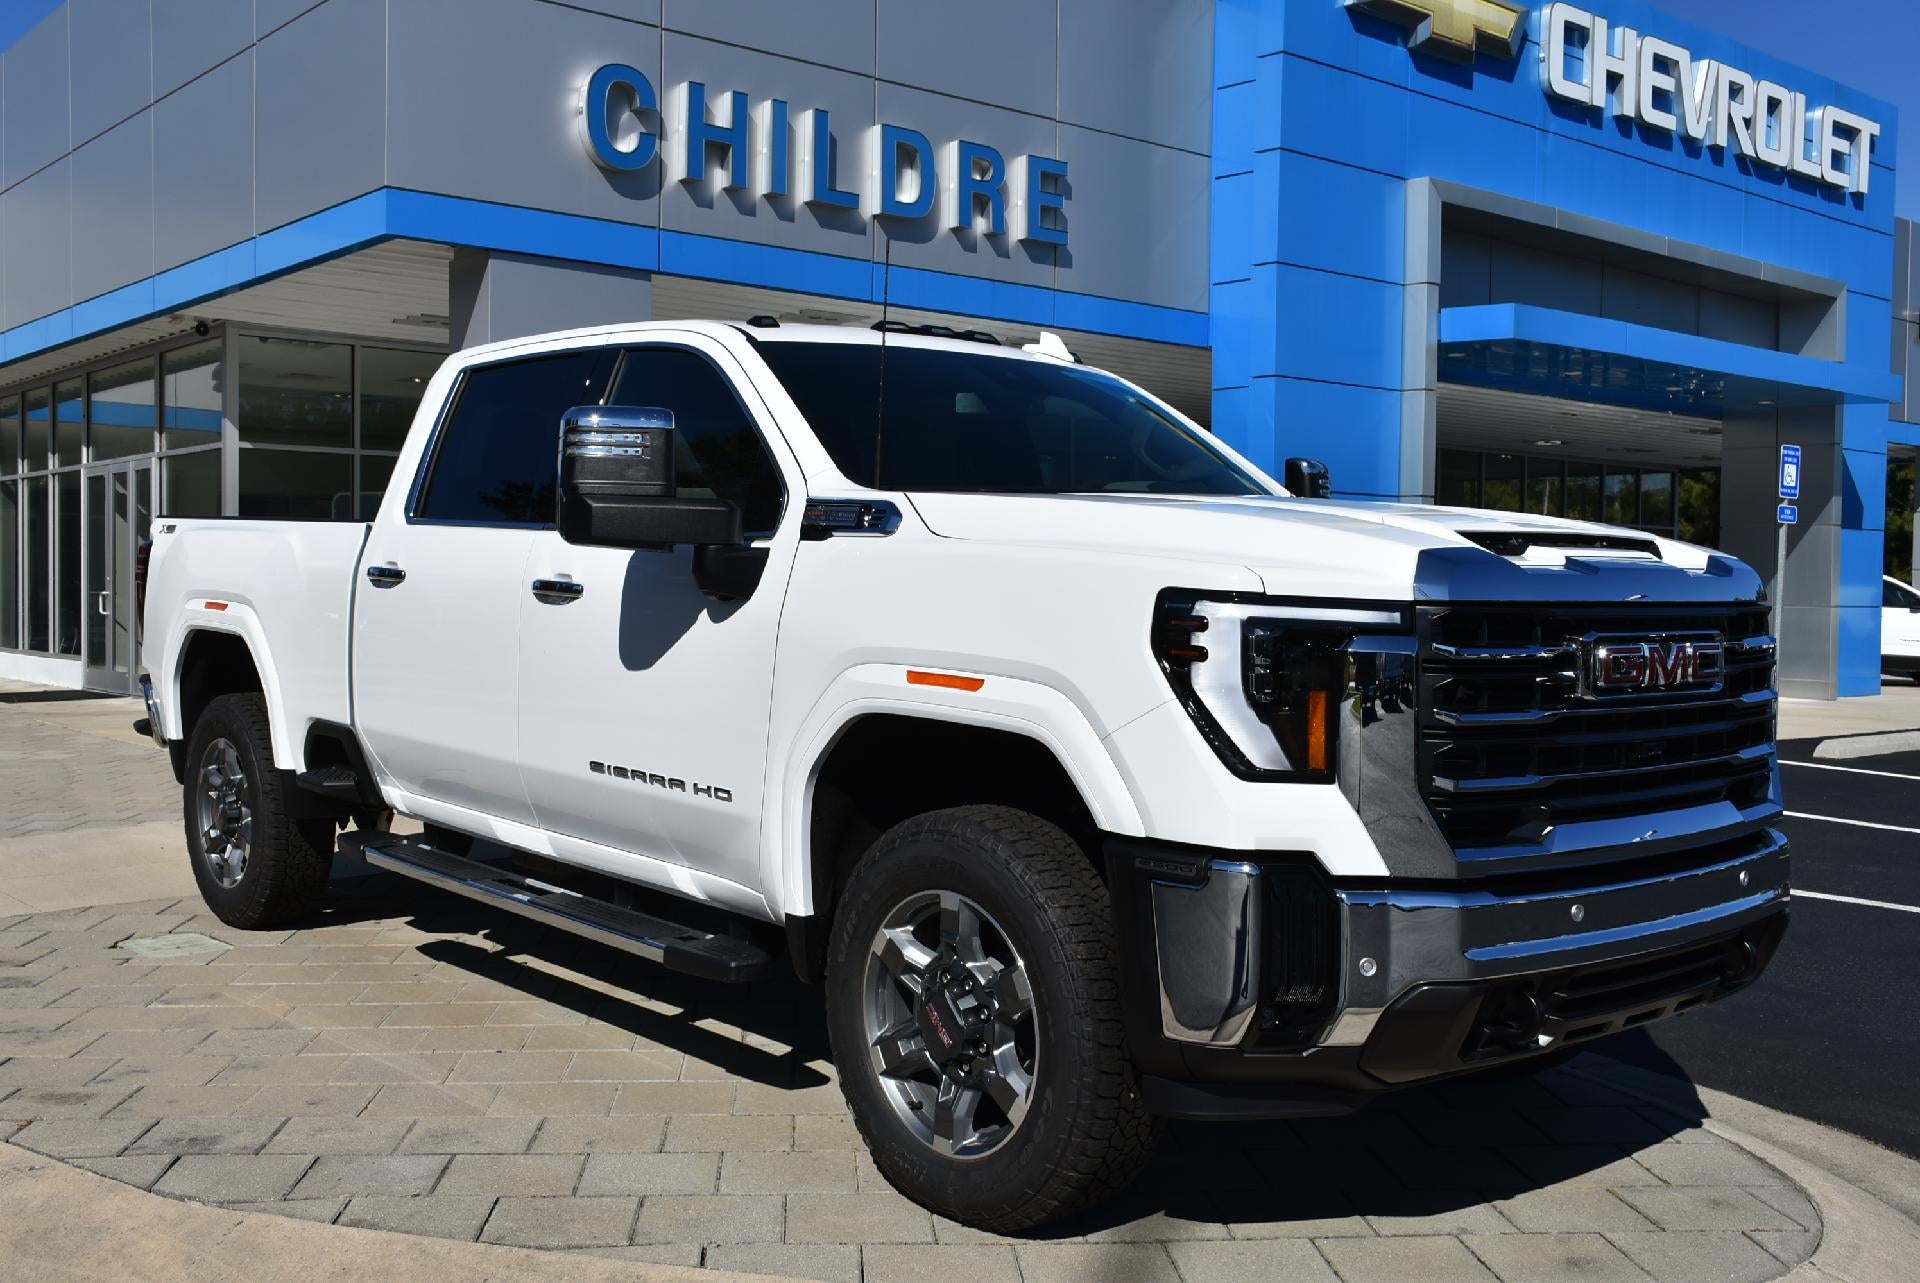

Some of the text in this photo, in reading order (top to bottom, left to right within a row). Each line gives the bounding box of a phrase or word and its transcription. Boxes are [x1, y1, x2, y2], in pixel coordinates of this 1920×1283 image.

[1544, 2, 1880, 194] CHEVROLET
[581, 63, 1069, 246] CHILDRE
[1601, 643, 1721, 685] GMC
[589, 760, 733, 802] SIERRA HD
